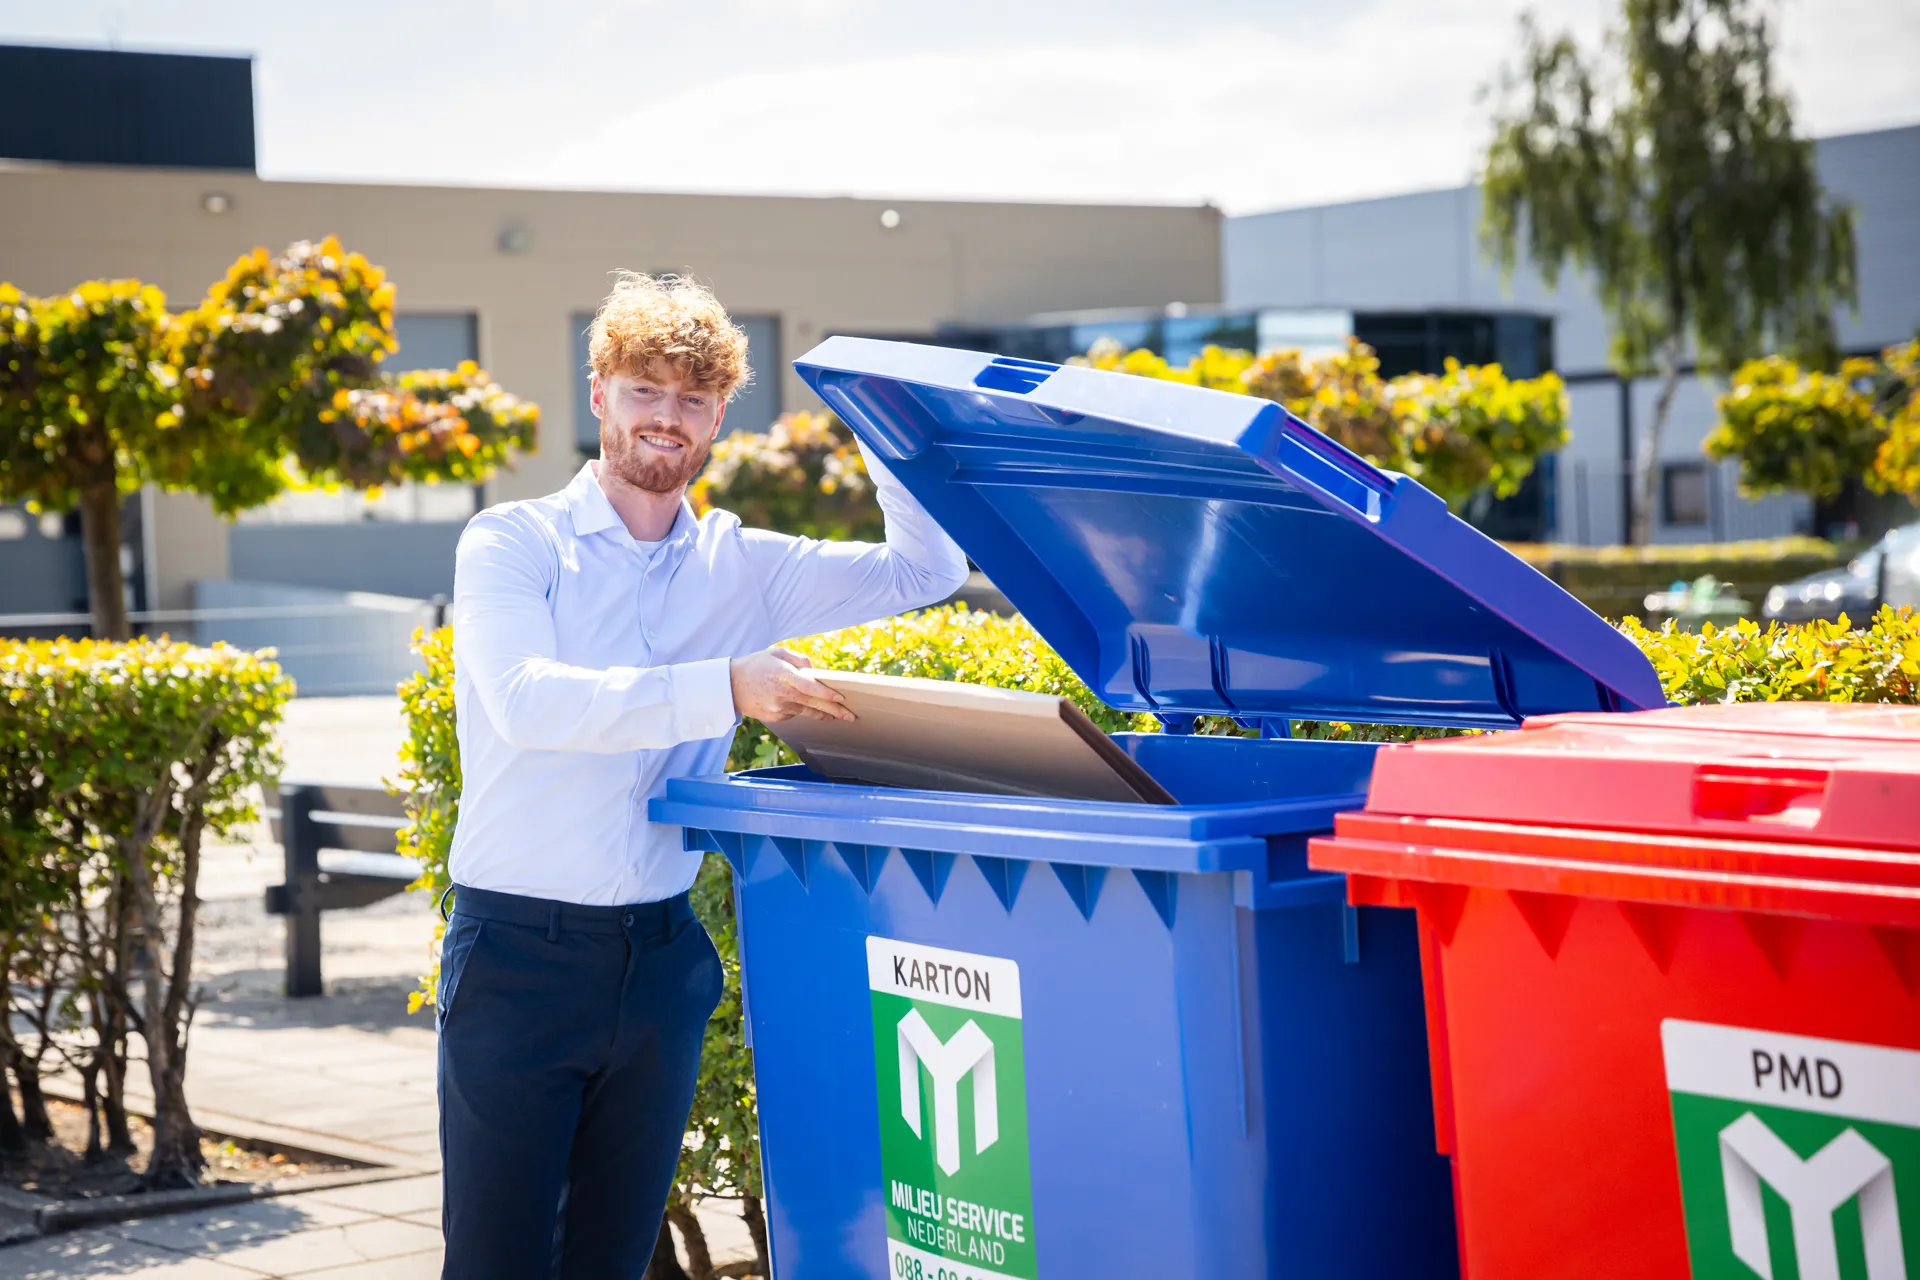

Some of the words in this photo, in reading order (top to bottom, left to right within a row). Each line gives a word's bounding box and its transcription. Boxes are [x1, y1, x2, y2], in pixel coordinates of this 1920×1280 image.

[893, 955, 991, 1002] KARTON
[1752, 1049, 1843, 1100] PMD
[891, 1179, 943, 1221] MILIEU
[946, 1197, 1026, 1243] SERVICE
[907, 1216, 1005, 1266] NEDERLAND
